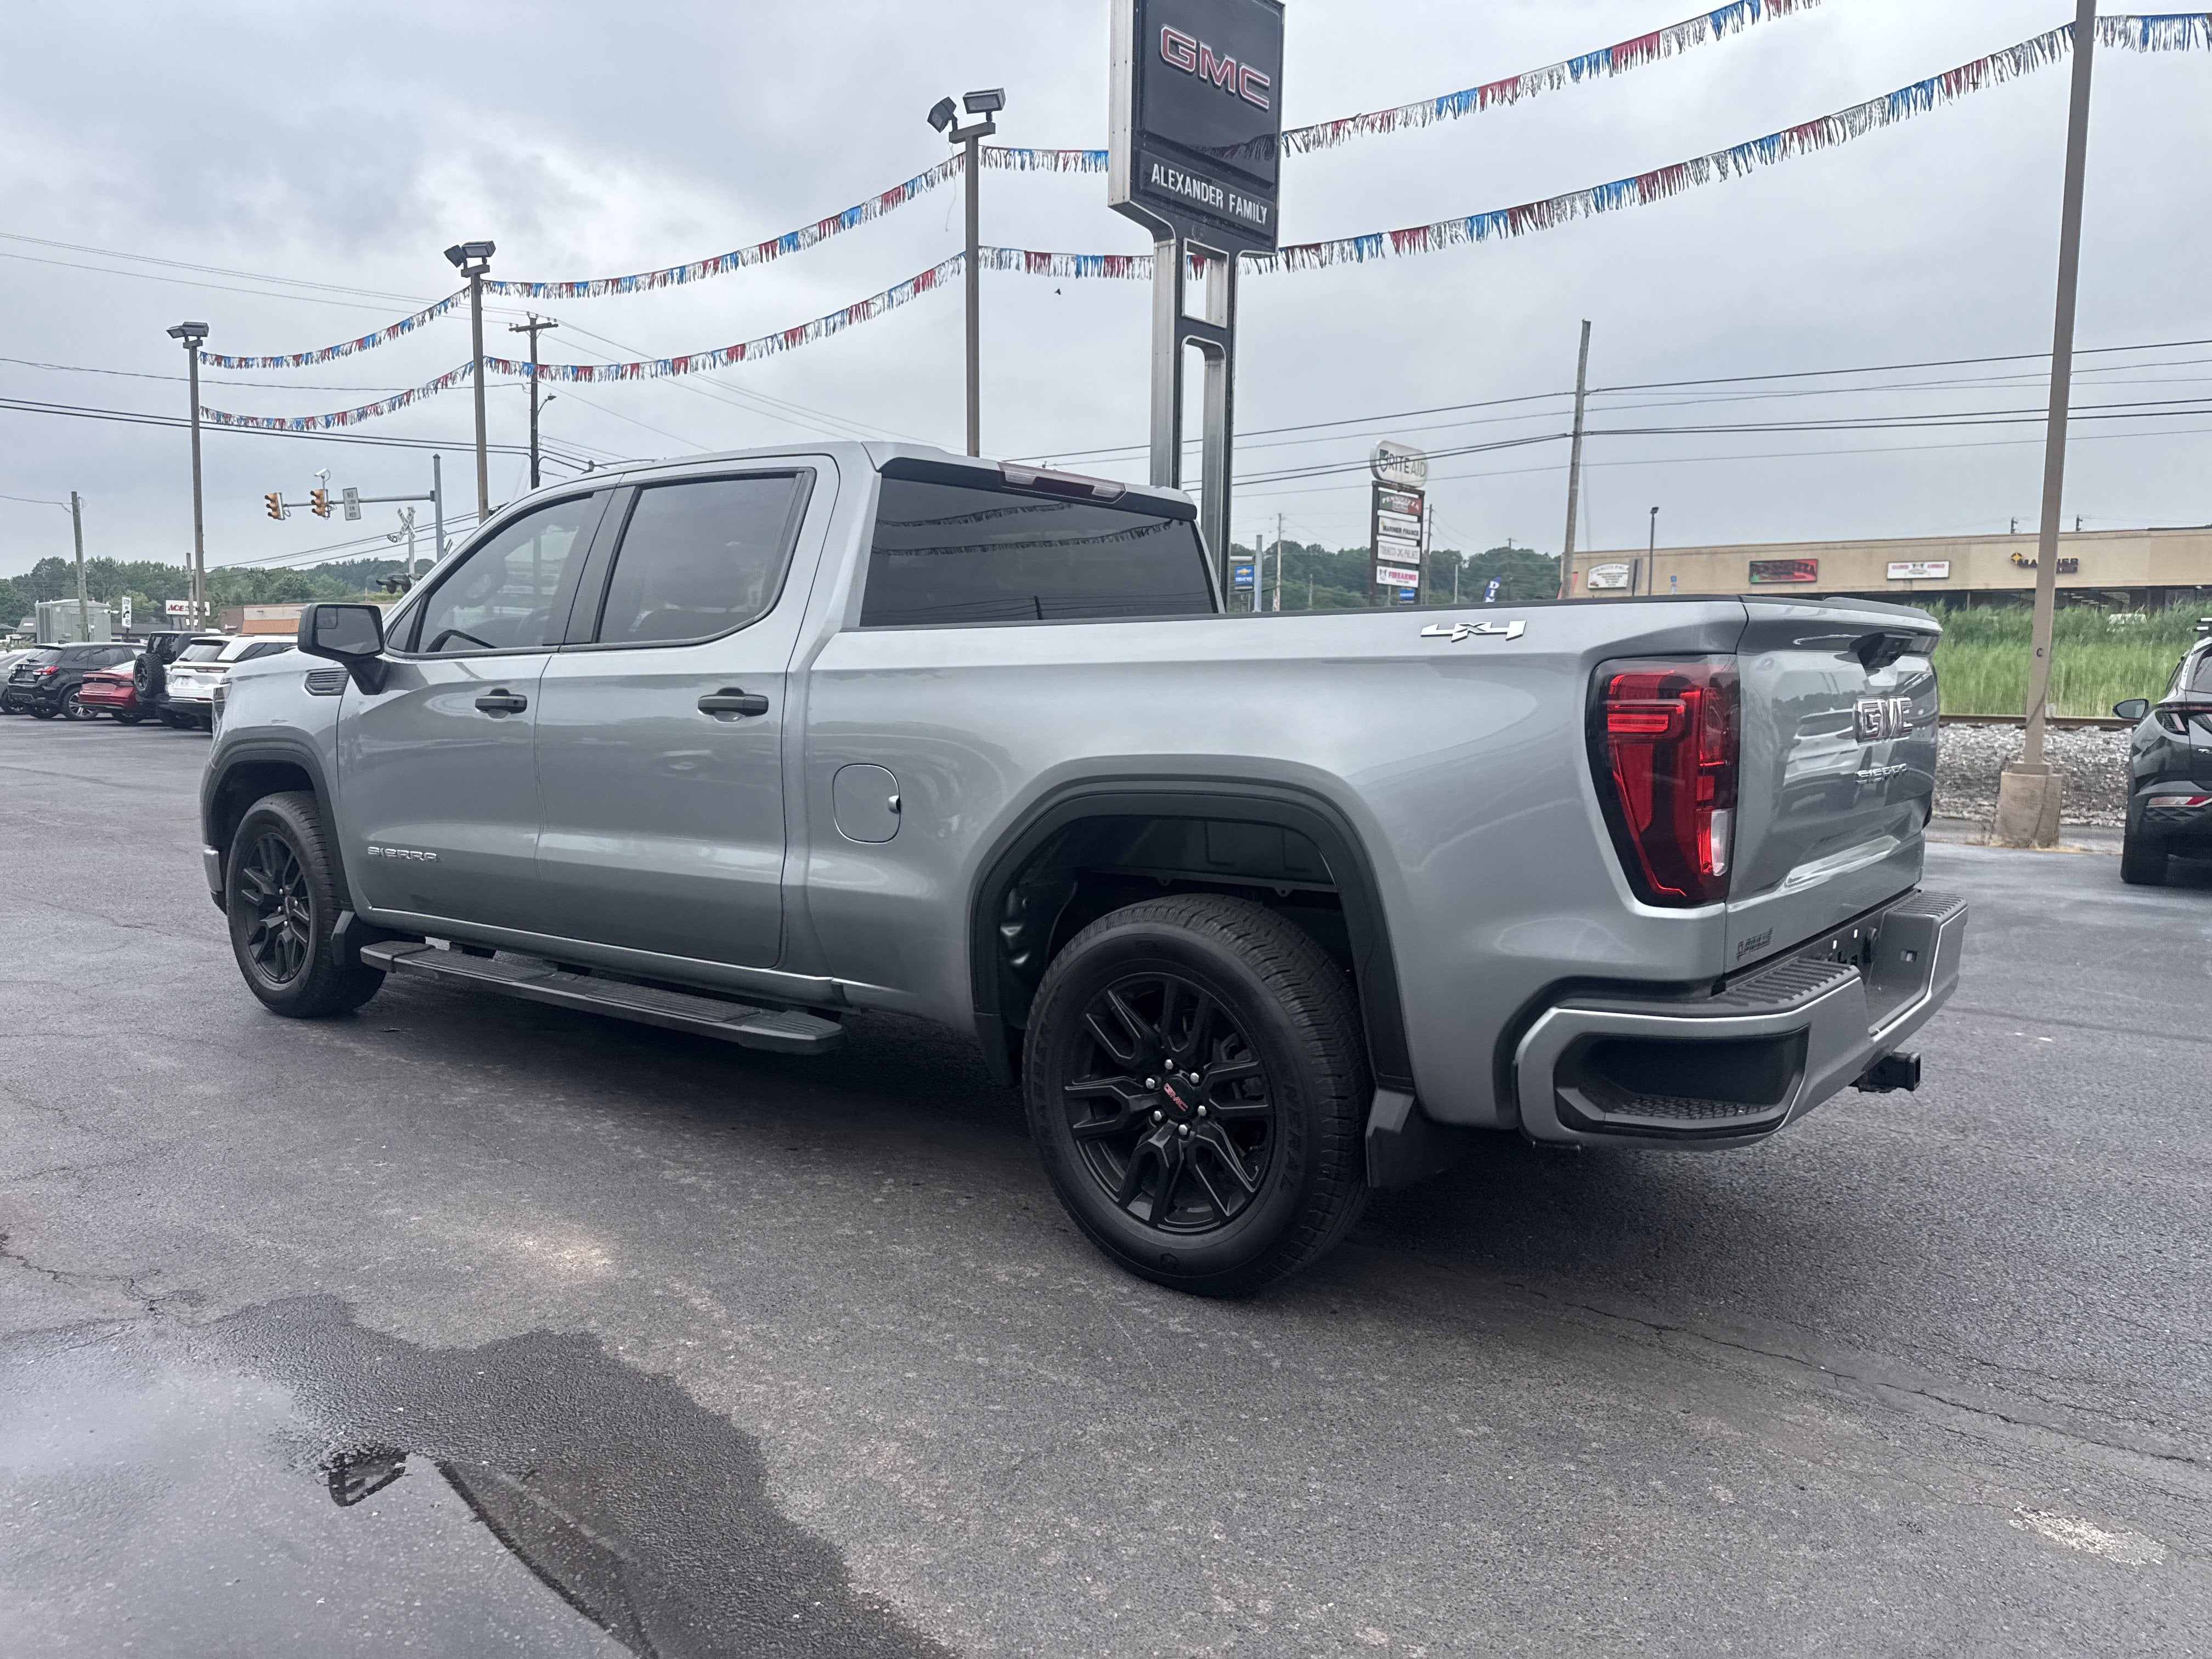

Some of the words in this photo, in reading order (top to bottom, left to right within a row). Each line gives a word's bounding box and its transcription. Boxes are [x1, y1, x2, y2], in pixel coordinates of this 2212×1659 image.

[1160, 25, 1270, 110] GMC
[1152, 163, 1223, 210] ALEXANDER
[1229, 194, 1267, 225] FAMILY
[1389, 454, 1409, 473] RITE
[1410, 461, 1426, 477] AID
[1383, 525, 1402, 534] MARINER
[1389, 571, 1417, 581] FIREARMS
[1853, 697, 1914, 744] GMC
[368, 847, 440, 862] SIERRA
[1164, 1083, 1188, 1111] GMC
